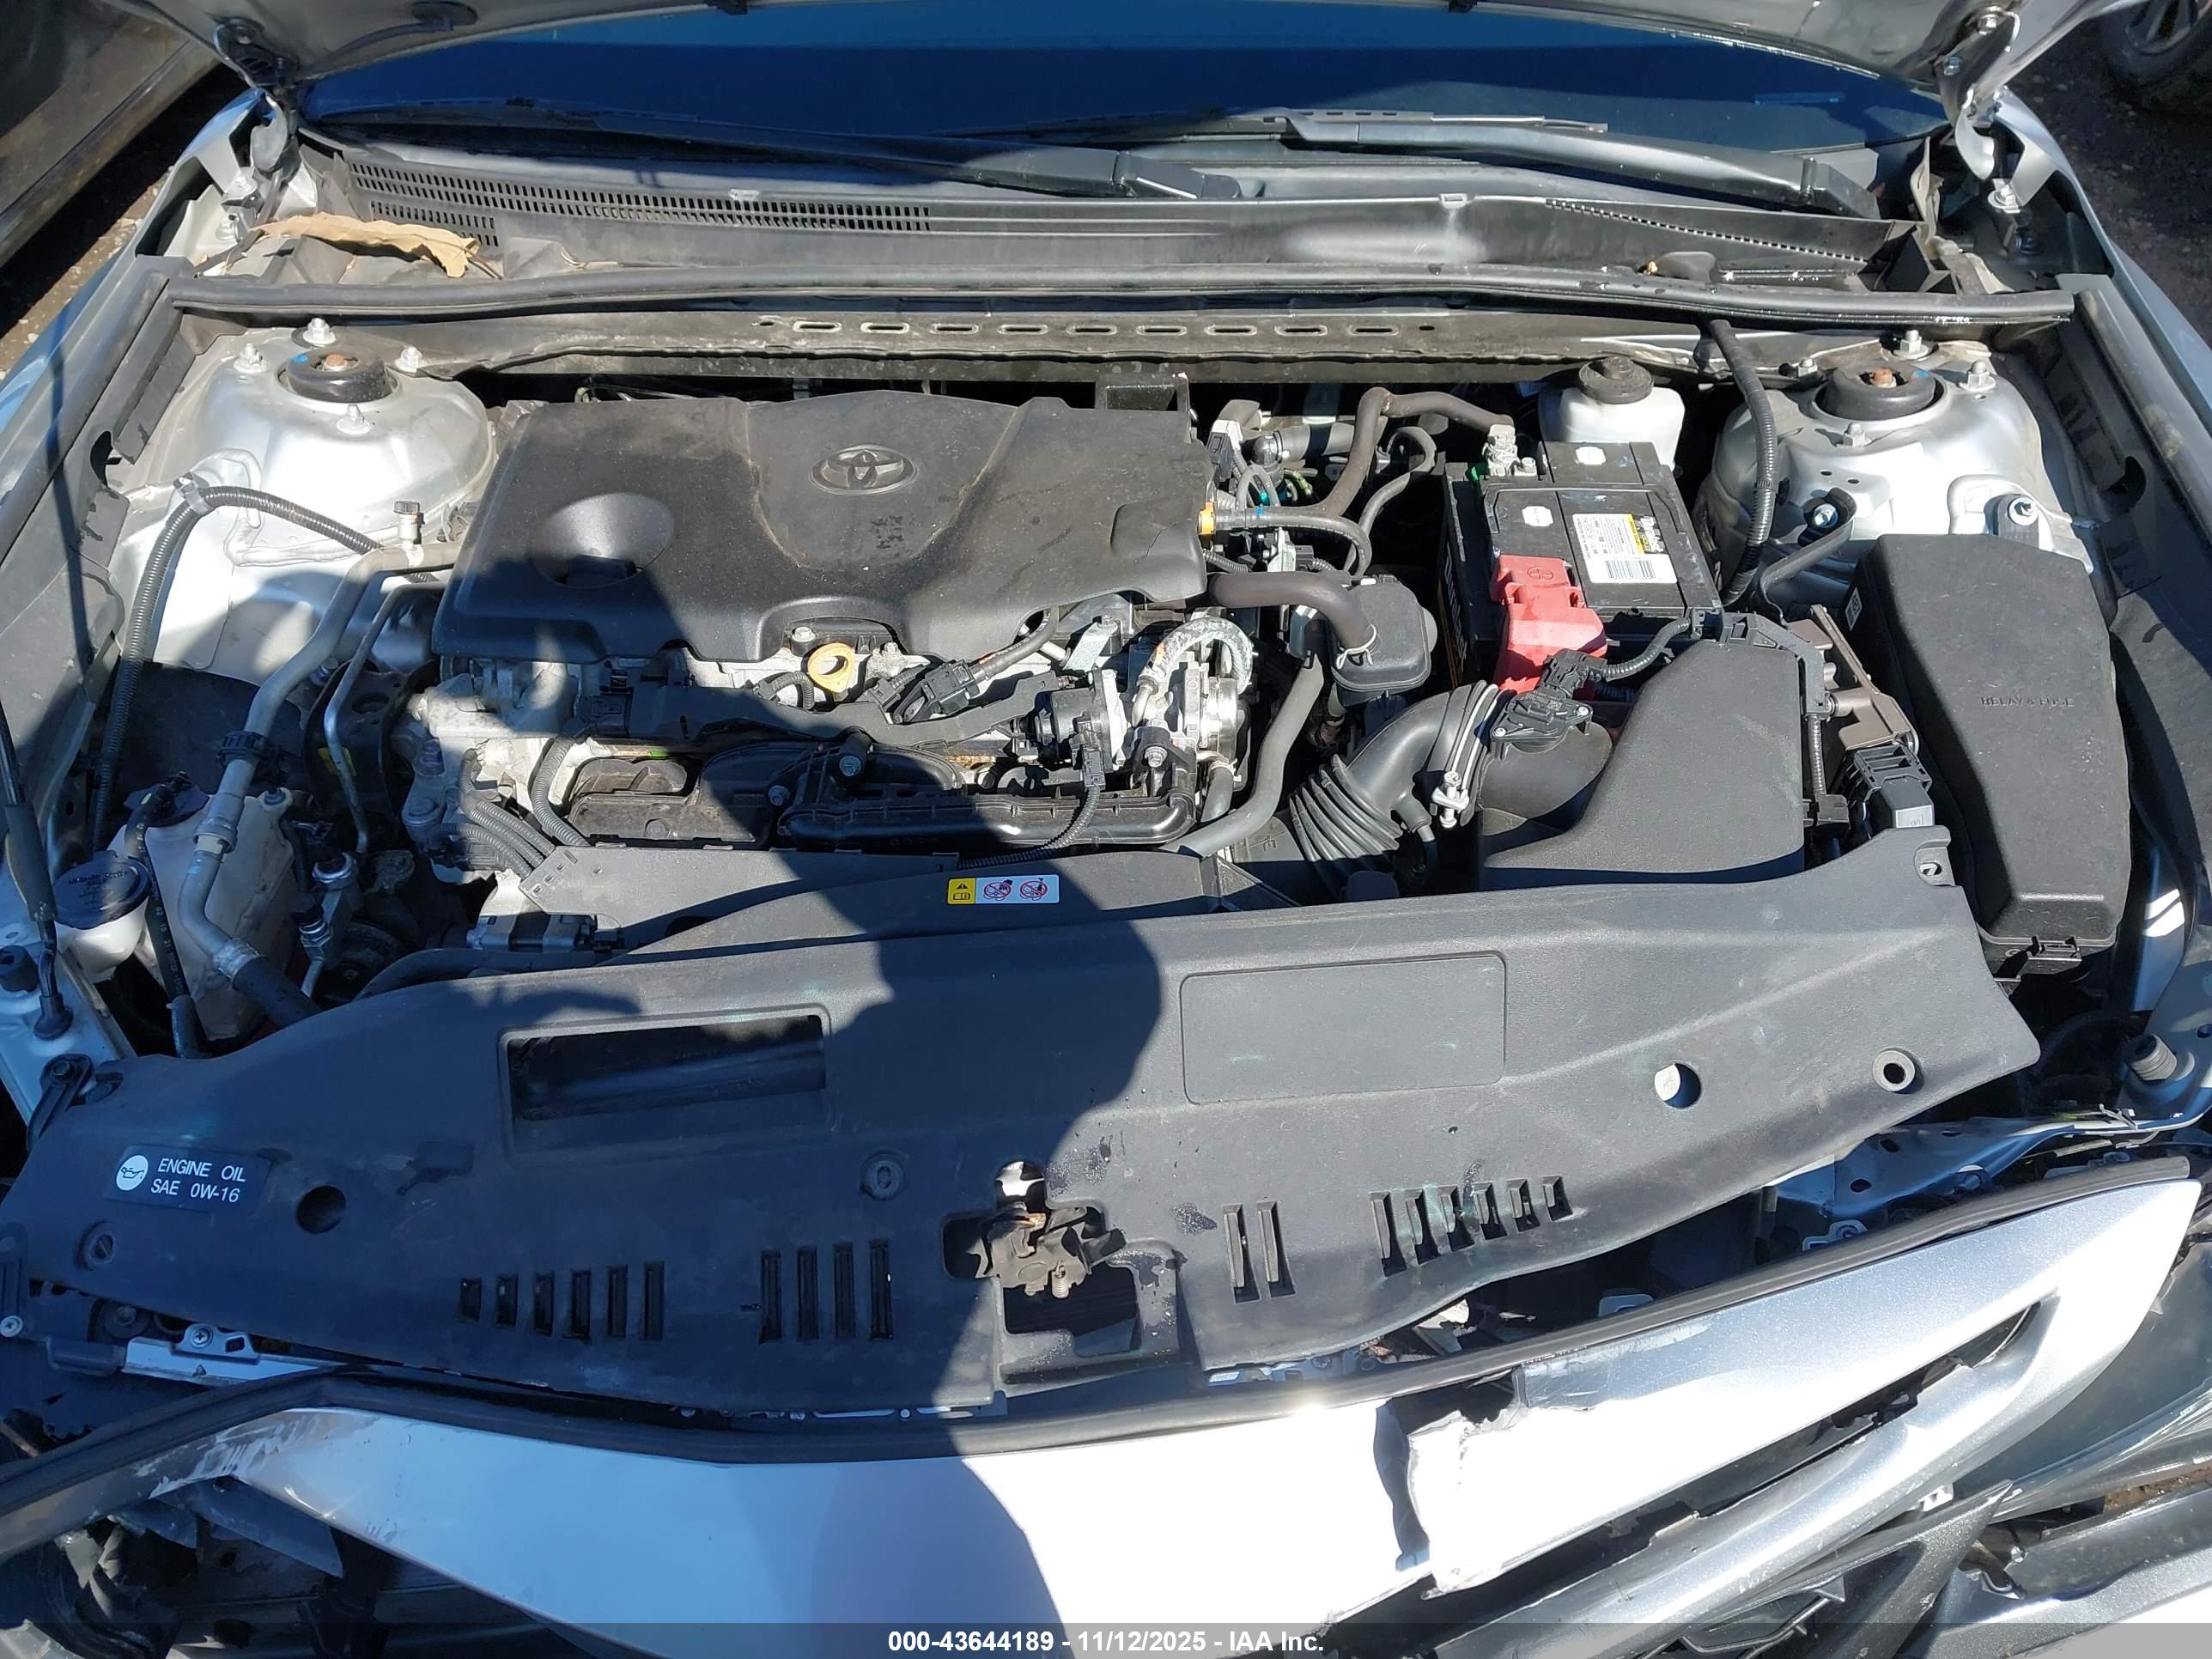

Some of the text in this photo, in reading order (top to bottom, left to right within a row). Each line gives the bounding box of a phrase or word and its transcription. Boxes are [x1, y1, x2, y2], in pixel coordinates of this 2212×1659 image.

[1980, 696, 2022, 707] RELAY
[157, 1158, 246, 1182] ENGINE OIL
[150, 1178, 240, 1202] SAE 0W-16
